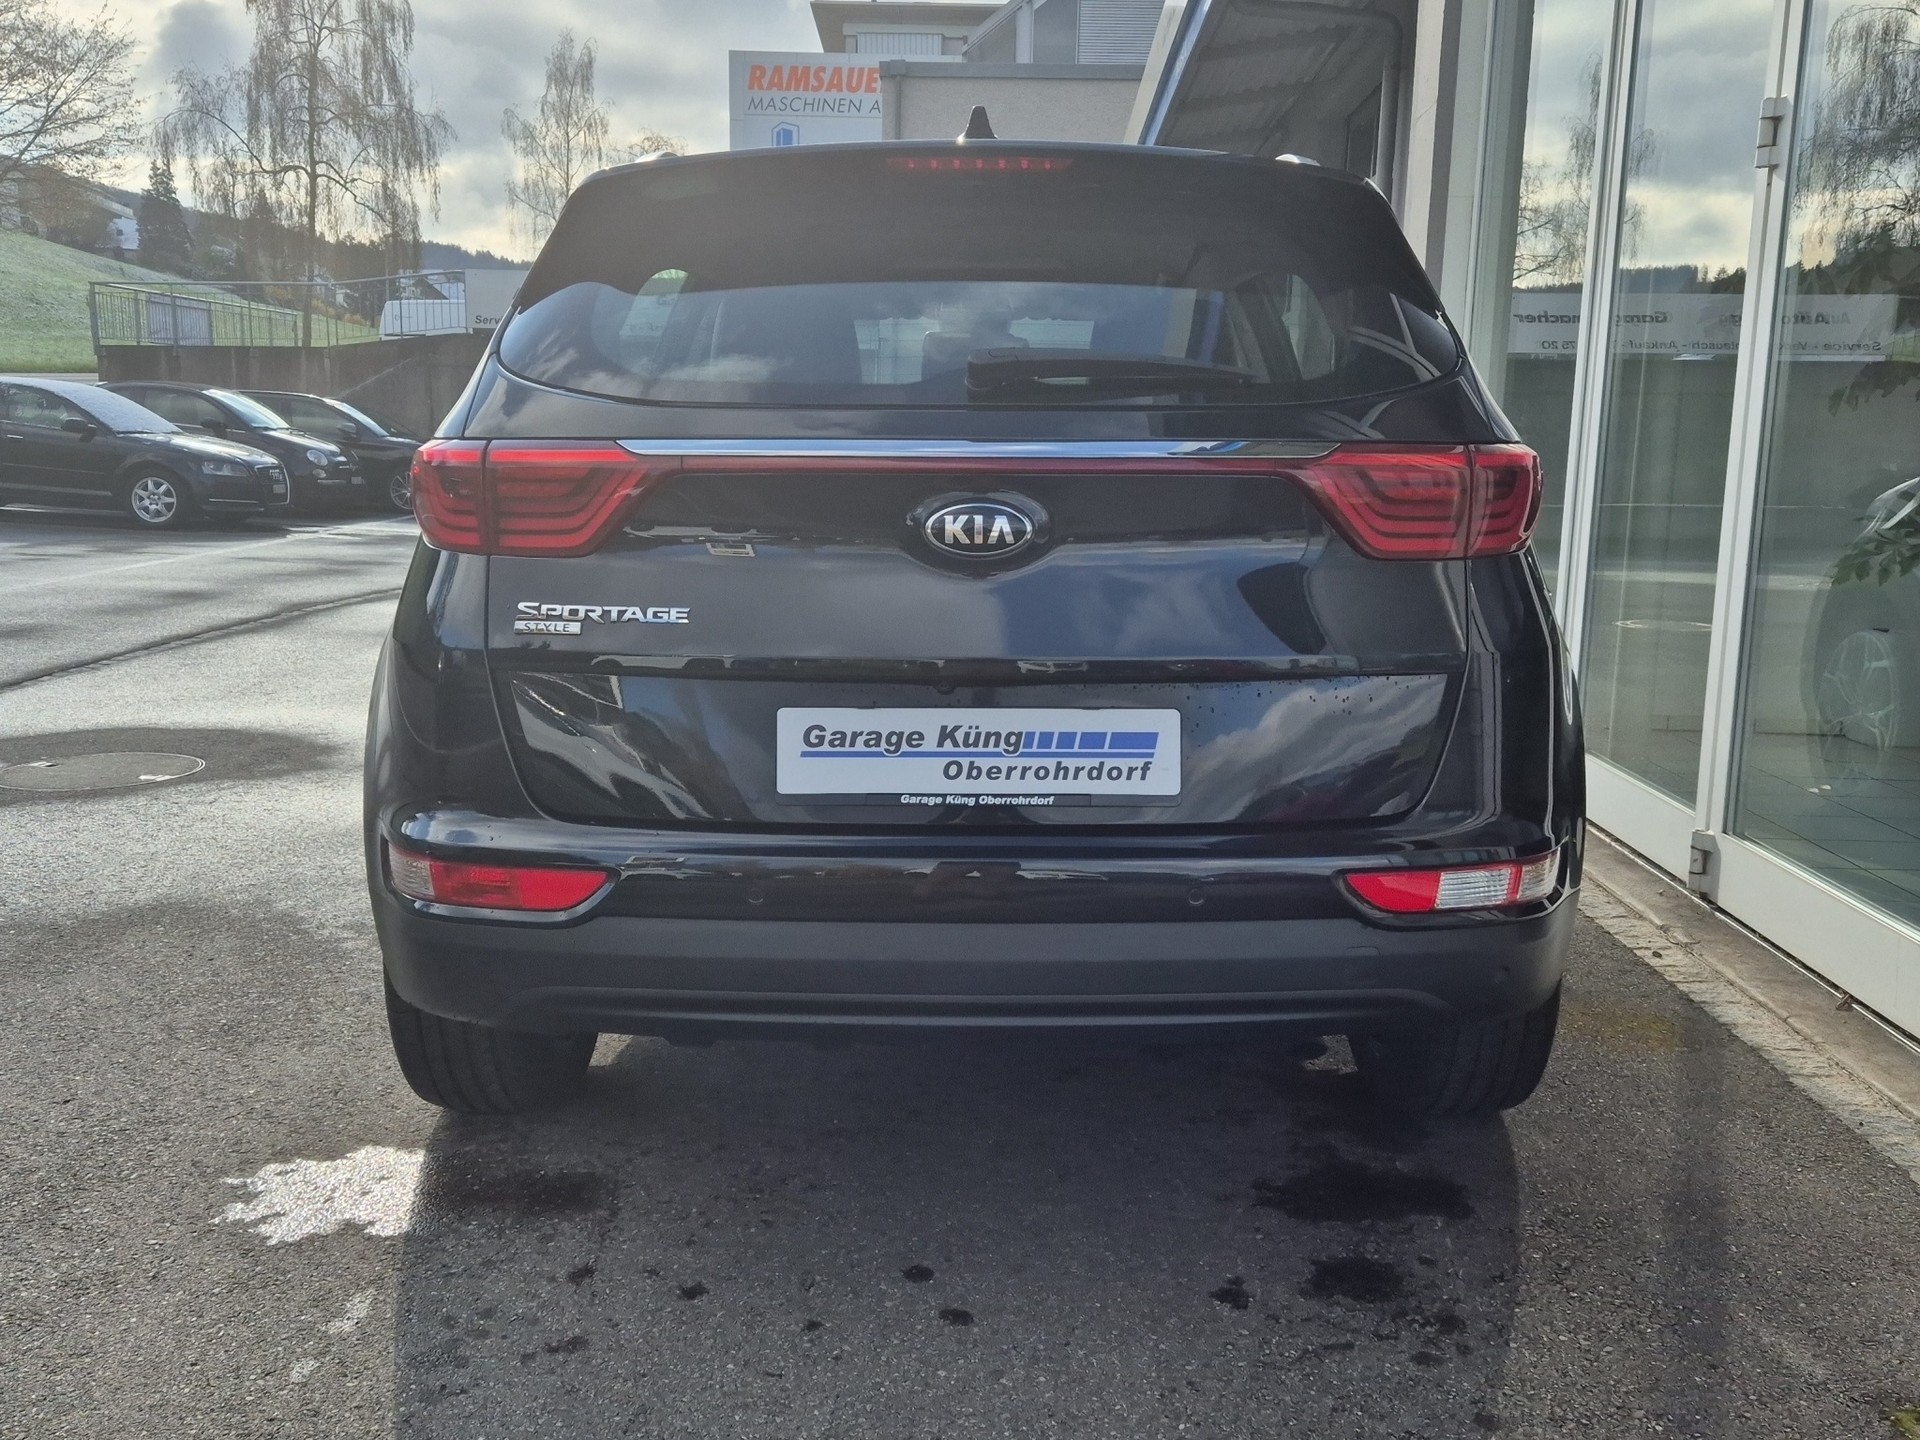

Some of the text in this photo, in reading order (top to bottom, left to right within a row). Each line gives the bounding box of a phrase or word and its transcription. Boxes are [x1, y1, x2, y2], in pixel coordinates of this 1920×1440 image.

[747, 64, 882, 94] RAMSAUE
[748, 96, 863, 114] MASCHINEN
[475, 314, 504, 325] Serv
[943, 514, 1015, 545] KIA
[515, 601, 691, 624] SPORTAGE
[522, 621, 571, 634] STYLE
[801, 724, 1025, 756] Garage Küng
[942, 760, 1153, 782] Oberrohrdorf
[900, 794, 1055, 806] Garage Küng Oberrohrdorf
